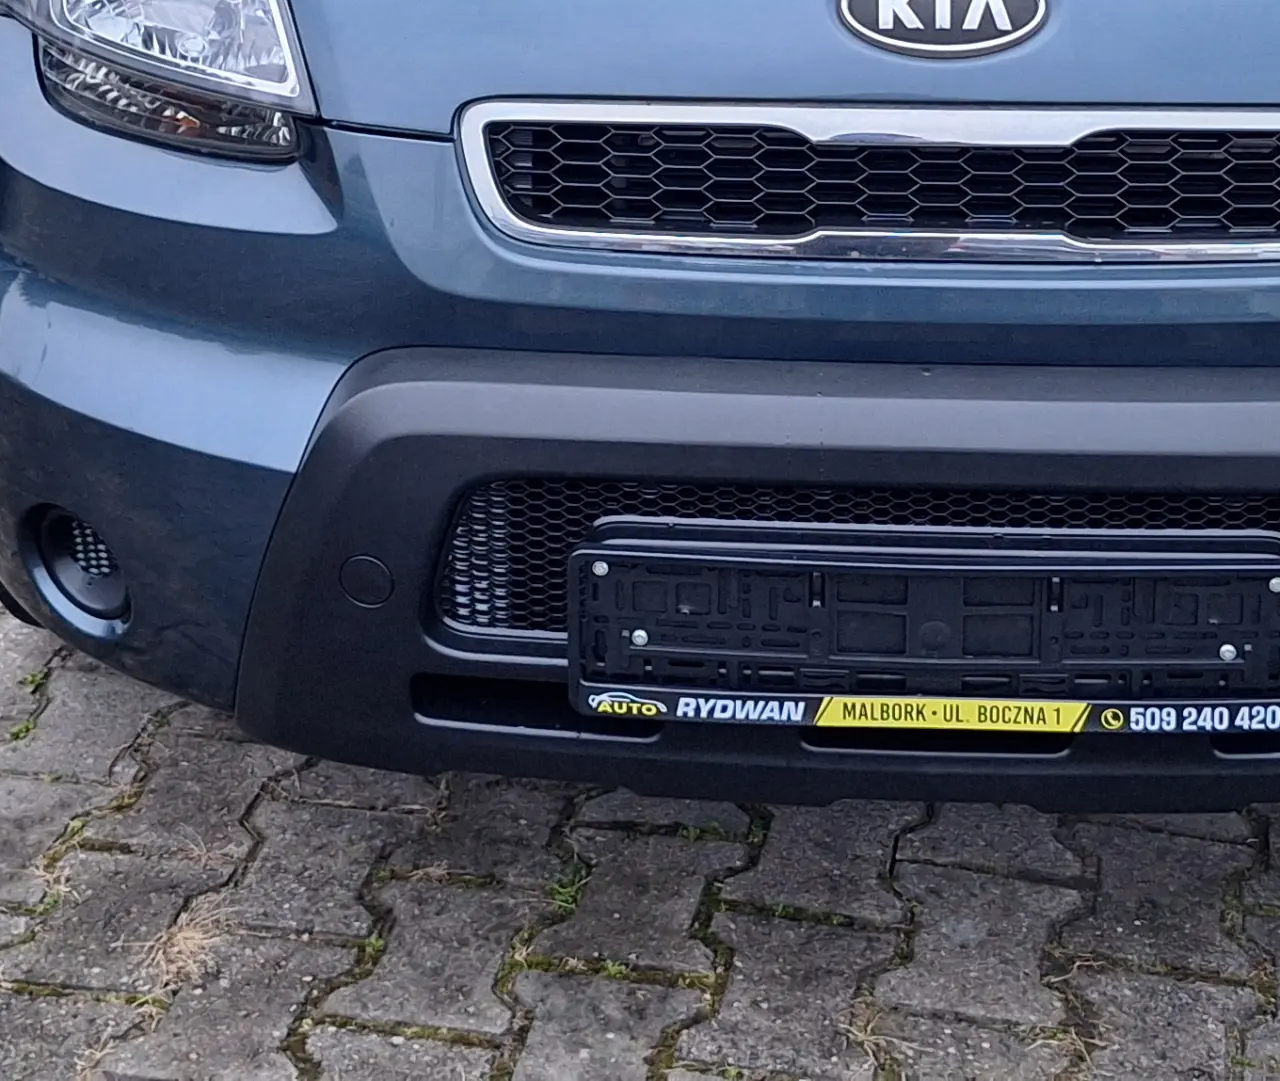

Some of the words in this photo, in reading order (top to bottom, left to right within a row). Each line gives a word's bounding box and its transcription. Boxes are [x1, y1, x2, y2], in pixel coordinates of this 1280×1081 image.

[596, 700, 658, 716] AUTO
[676, 696, 805, 721] RYDWAN
[842, 702, 926, 722] MALBORK
[943, 704, 970, 723] UL.
[977, 705, 1047, 726] BOCZNA
[1052, 707, 1061, 726] 1
[1129, 706, 1177, 731] 509
[1182, 707, 1230, 731] 240
